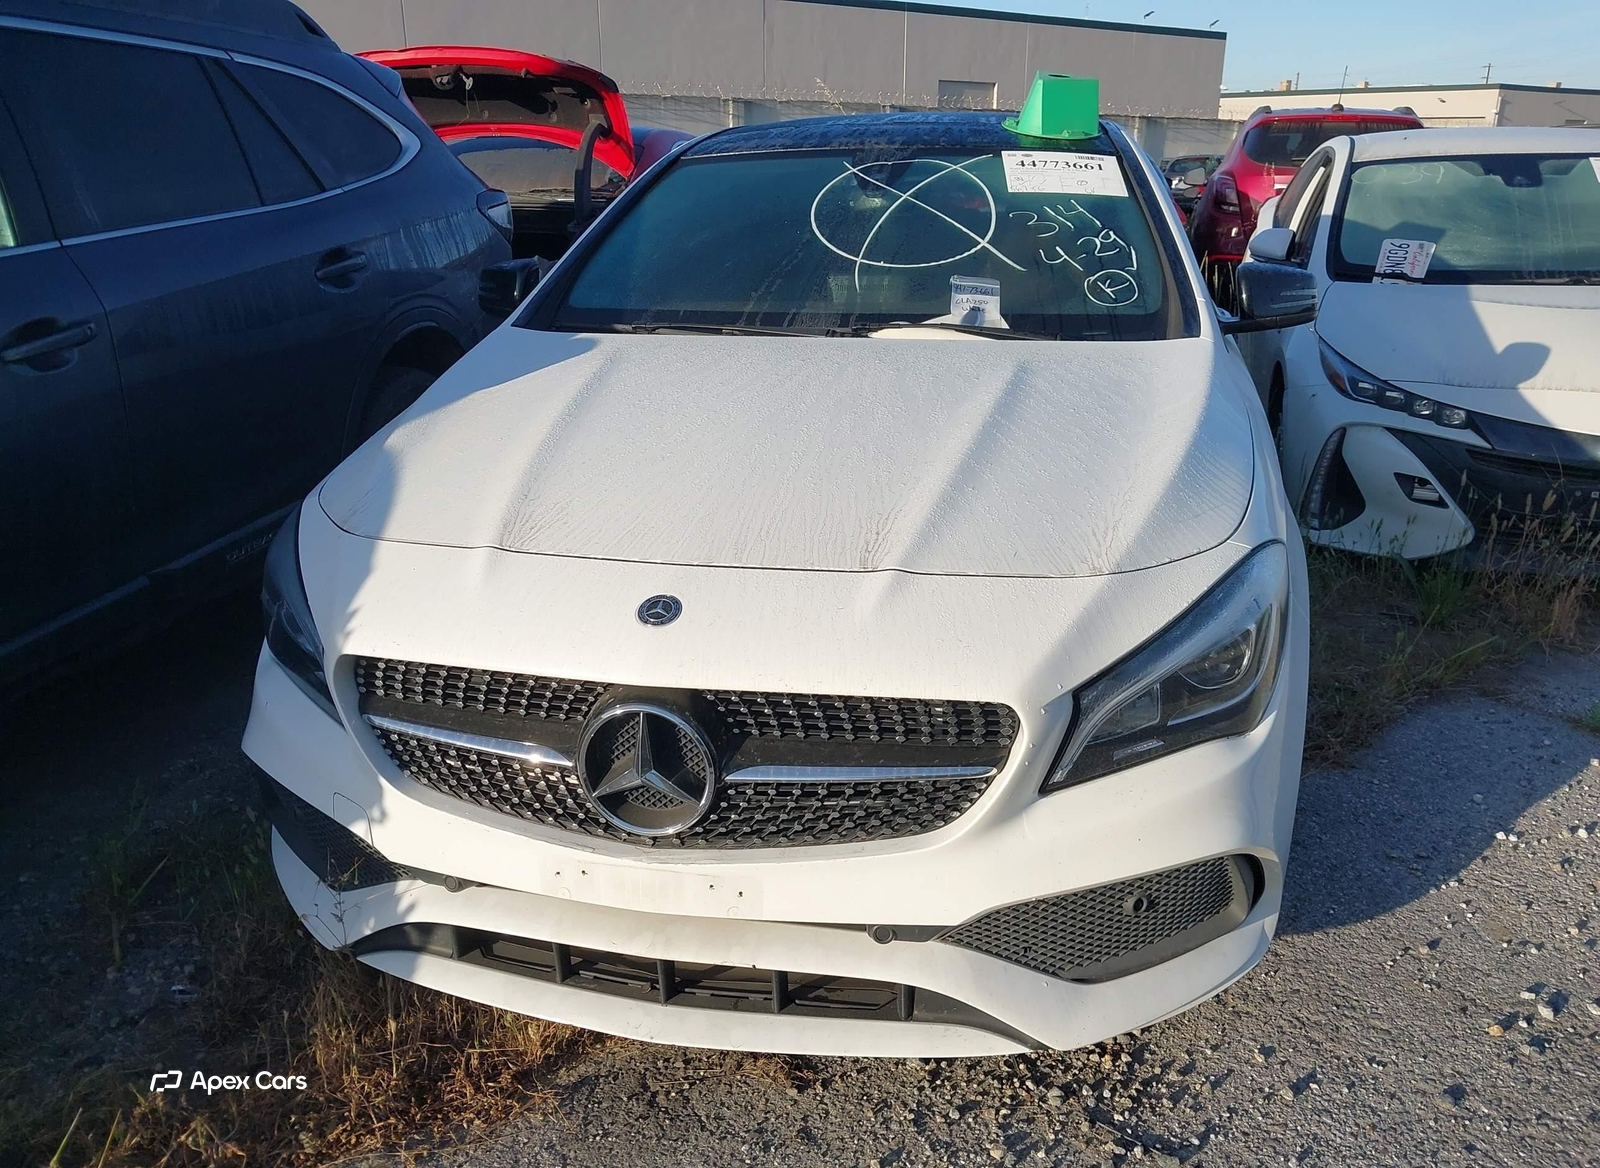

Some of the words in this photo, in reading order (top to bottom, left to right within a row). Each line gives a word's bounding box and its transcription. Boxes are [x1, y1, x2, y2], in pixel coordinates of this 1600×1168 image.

[1015, 159, 1104, 172] 44773661
[1009, 199, 1102, 238] 314
[1380, 241, 1411, 284] 9GDN8
